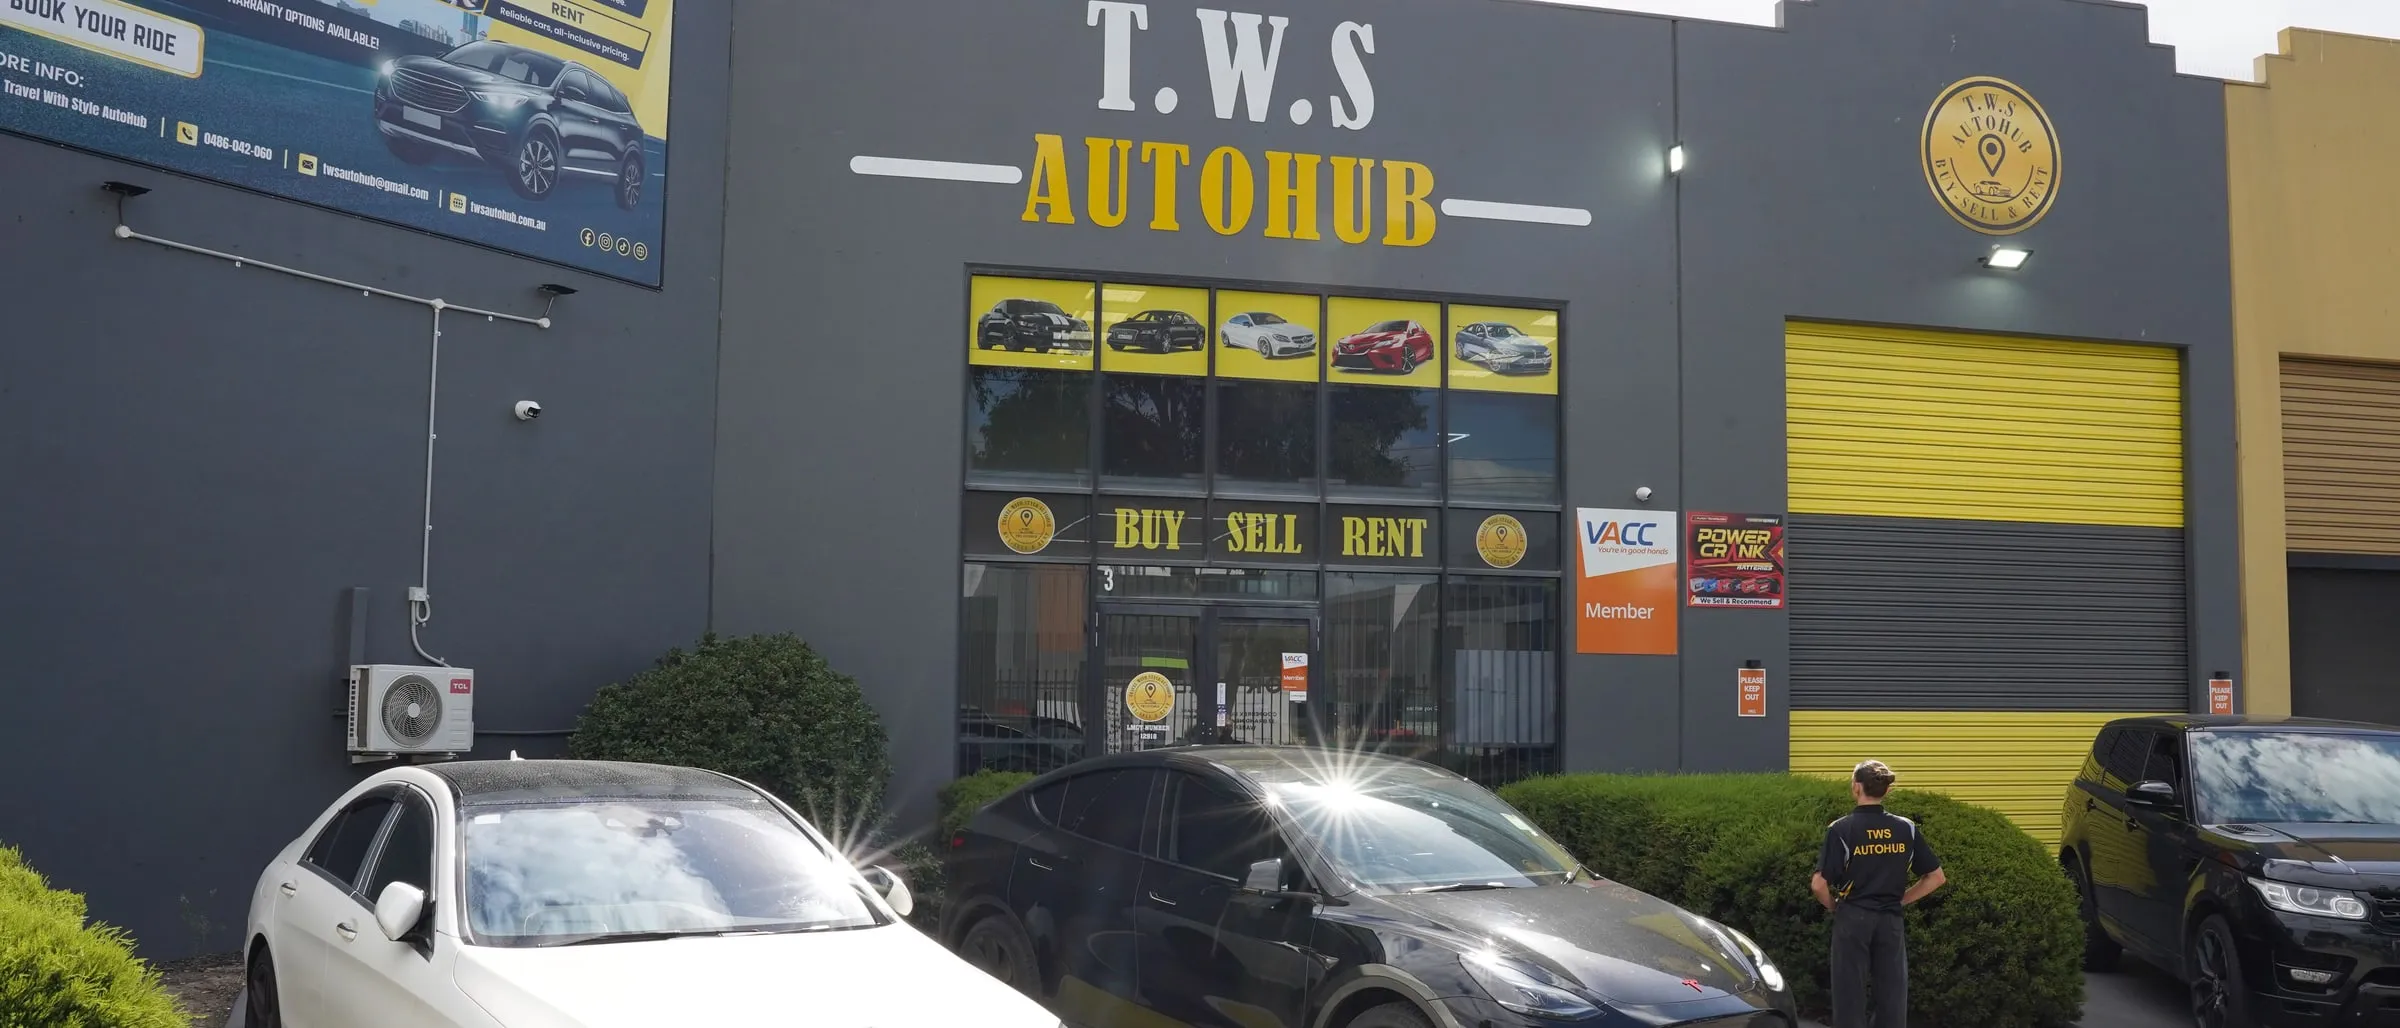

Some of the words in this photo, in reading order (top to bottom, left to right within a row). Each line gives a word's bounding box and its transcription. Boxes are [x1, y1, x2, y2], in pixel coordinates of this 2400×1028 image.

[227, 0, 283, 18] RRANTY
[285, 8, 325, 32] OPTIONS
[327, 22, 380, 50] AVAILABLE!
[551, 2, 585, 24] RENT
[74, 5, 126, 41] YOUR
[133, 23, 177, 56] RIDE
[500, 7, 532, 25] Reliable
[533, 20, 553, 33] cars,
[554, 27, 601, 50] all-inclusive
[601, 44, 630, 61] pricing.
[35, 61, 84, 88] INFO:
[1087, 0, 1375, 130] T.W.S
[3, 79, 41, 101] Travel
[43, 89, 69, 109] With
[71, 97, 99, 117] Style
[102, 105, 148, 129] AutoHub
[1962, 93, 2017, 118] T.W.S
[203, 132, 273, 161] 0486-042-060
[1952, 114, 2033, 155] AUTOHUB
[322, 162, 429, 201] twsautohub@gmail.com
[1021, 133, 1437, 247] AUTOHUB
[2008, 205, 2018, 219] &
[2022, 166, 2048, 208] RENT
[470, 200, 547, 231] twsautohub.com.au
[1114, 508, 1185, 550] BUY
[1227, 511, 1302, 553] SELL
[1341, 516, 1427, 557] RENT
[1586, 521, 1657, 546] VACC
[1697, 528, 1771, 545] POWER
[1627, 547, 1646, 555] good
[1646, 547, 1669, 555] hands
[1700, 542, 1767, 560] CRANK
[1103, 568, 1114, 591] 3
[1585, 602, 1655, 619] Member
[1700, 596, 1711, 604] We
[1740, 676, 1764, 684] PLEASE
[1744, 685, 1760, 693] KEEP
[1744, 693, 1760, 701] OUT
[1866, 828, 1892, 840] TWS
[1853, 843, 1906, 856] AUTOHUB
